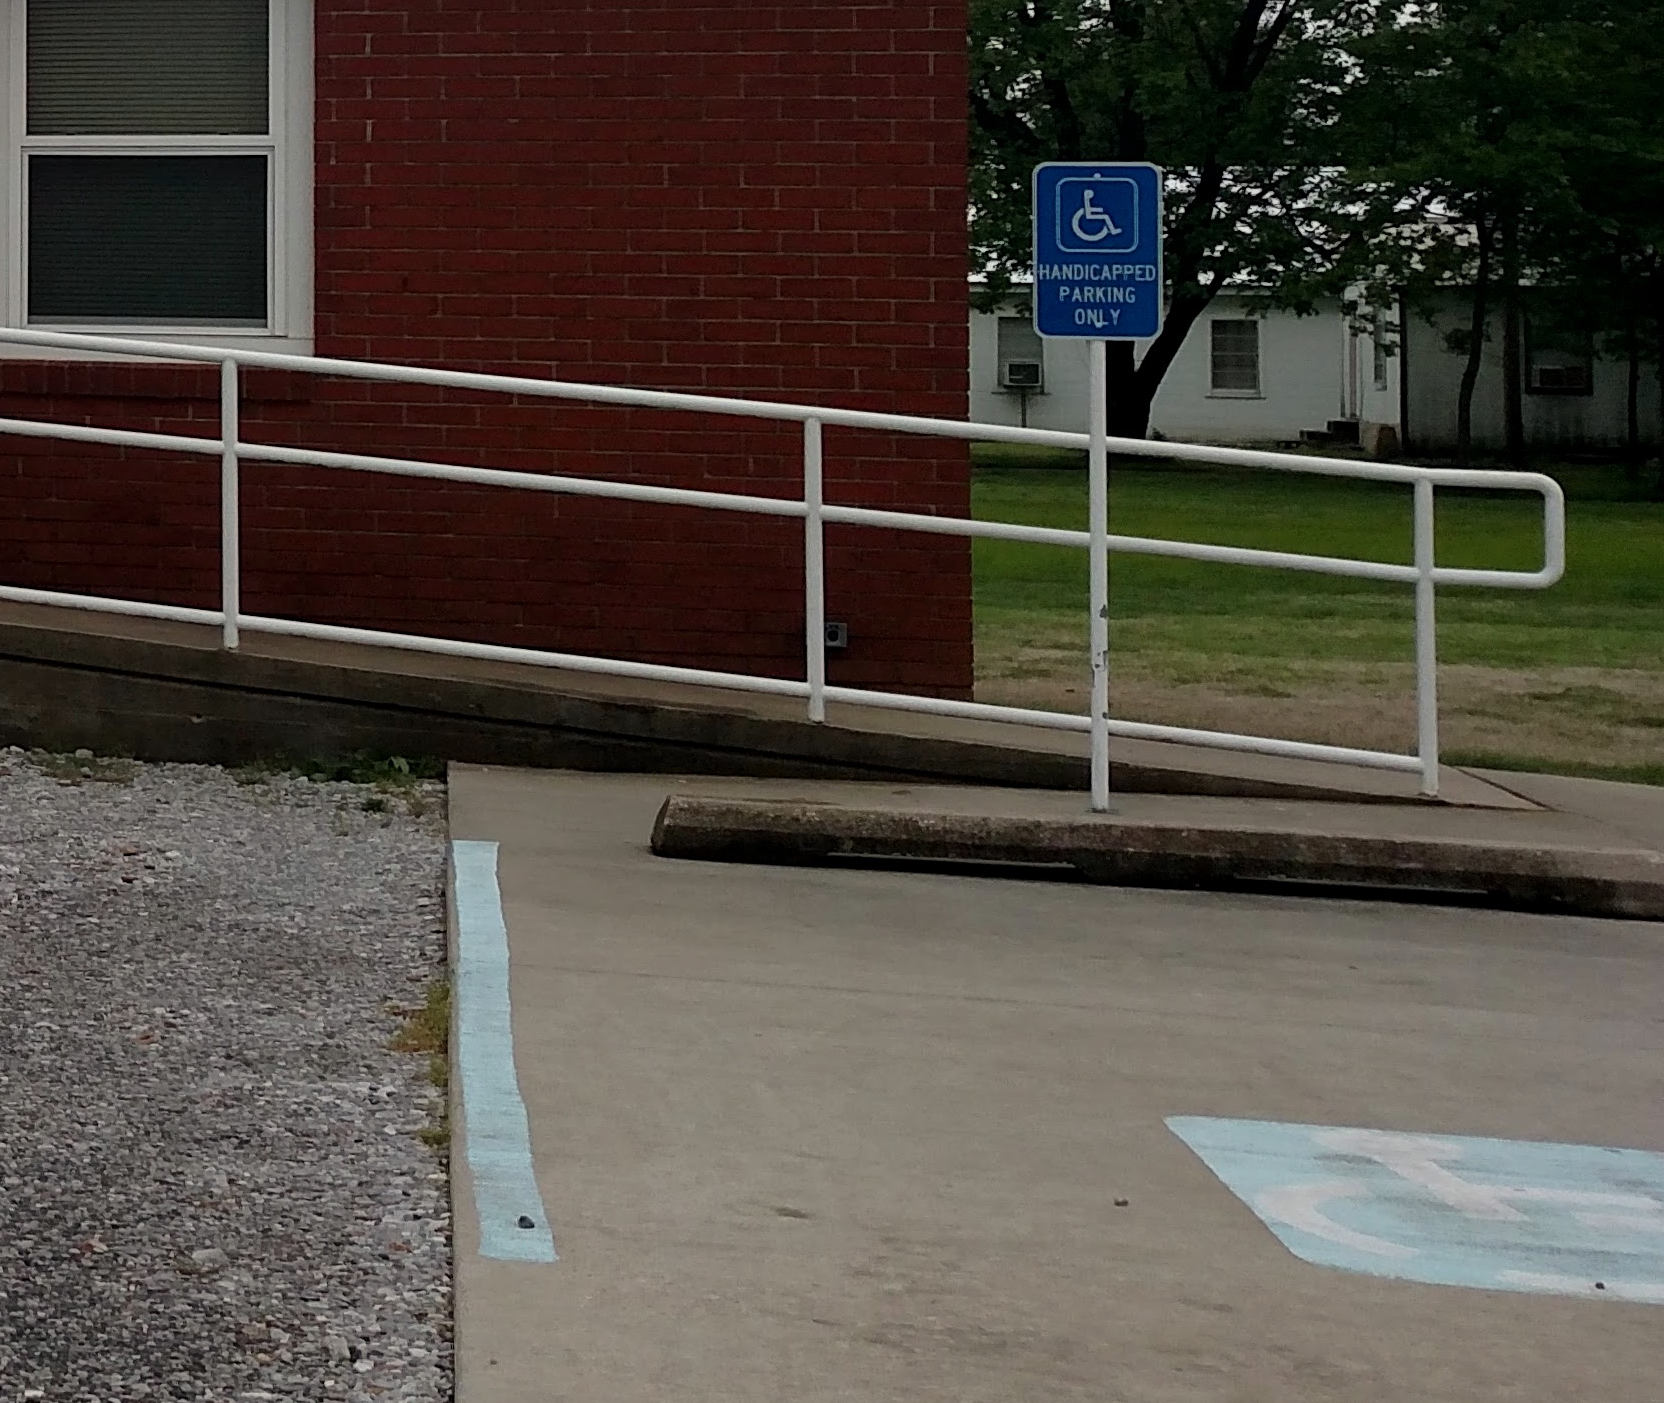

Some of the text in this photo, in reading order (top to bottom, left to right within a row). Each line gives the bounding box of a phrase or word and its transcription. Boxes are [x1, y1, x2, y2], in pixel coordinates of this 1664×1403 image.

[1039, 264, 1156, 282] HANDICAPPED
[1059, 286, 1136, 303] PARKING
[1074, 309, 1121, 327] ONLY
